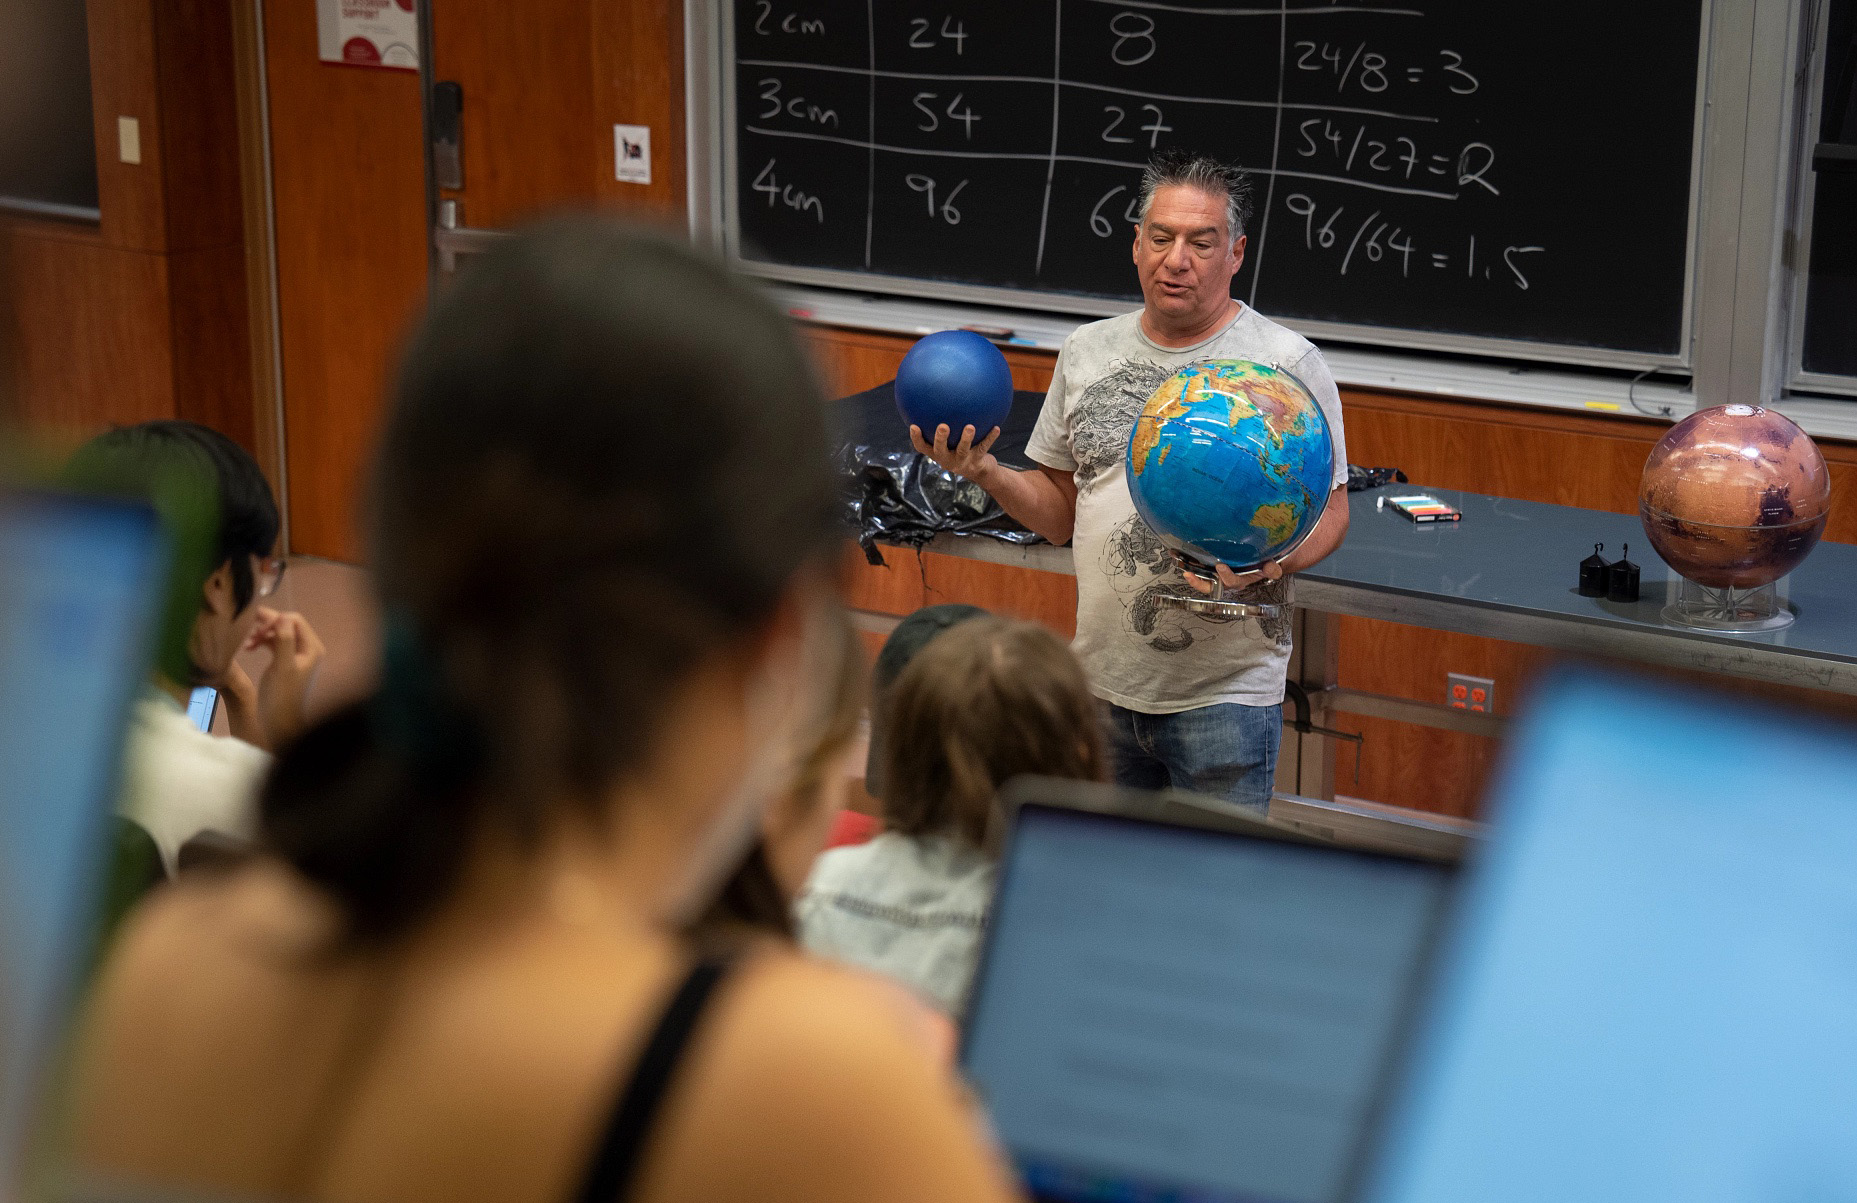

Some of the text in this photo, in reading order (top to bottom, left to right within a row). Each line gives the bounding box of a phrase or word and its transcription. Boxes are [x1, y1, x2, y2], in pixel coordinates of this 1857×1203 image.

[909, 15, 969, 55] 24
[1110, 11, 1157, 66] 8
[1295, 41, 1389, 92] 24/8
[757, 78, 839, 130] 3cm
[912, 92, 982, 141] 54
[1101, 103, 1173, 149] 27
[752, 158, 824, 224] 4cm
[904, 173, 969, 225] 96
[1286, 193, 1416, 276] 96/64
